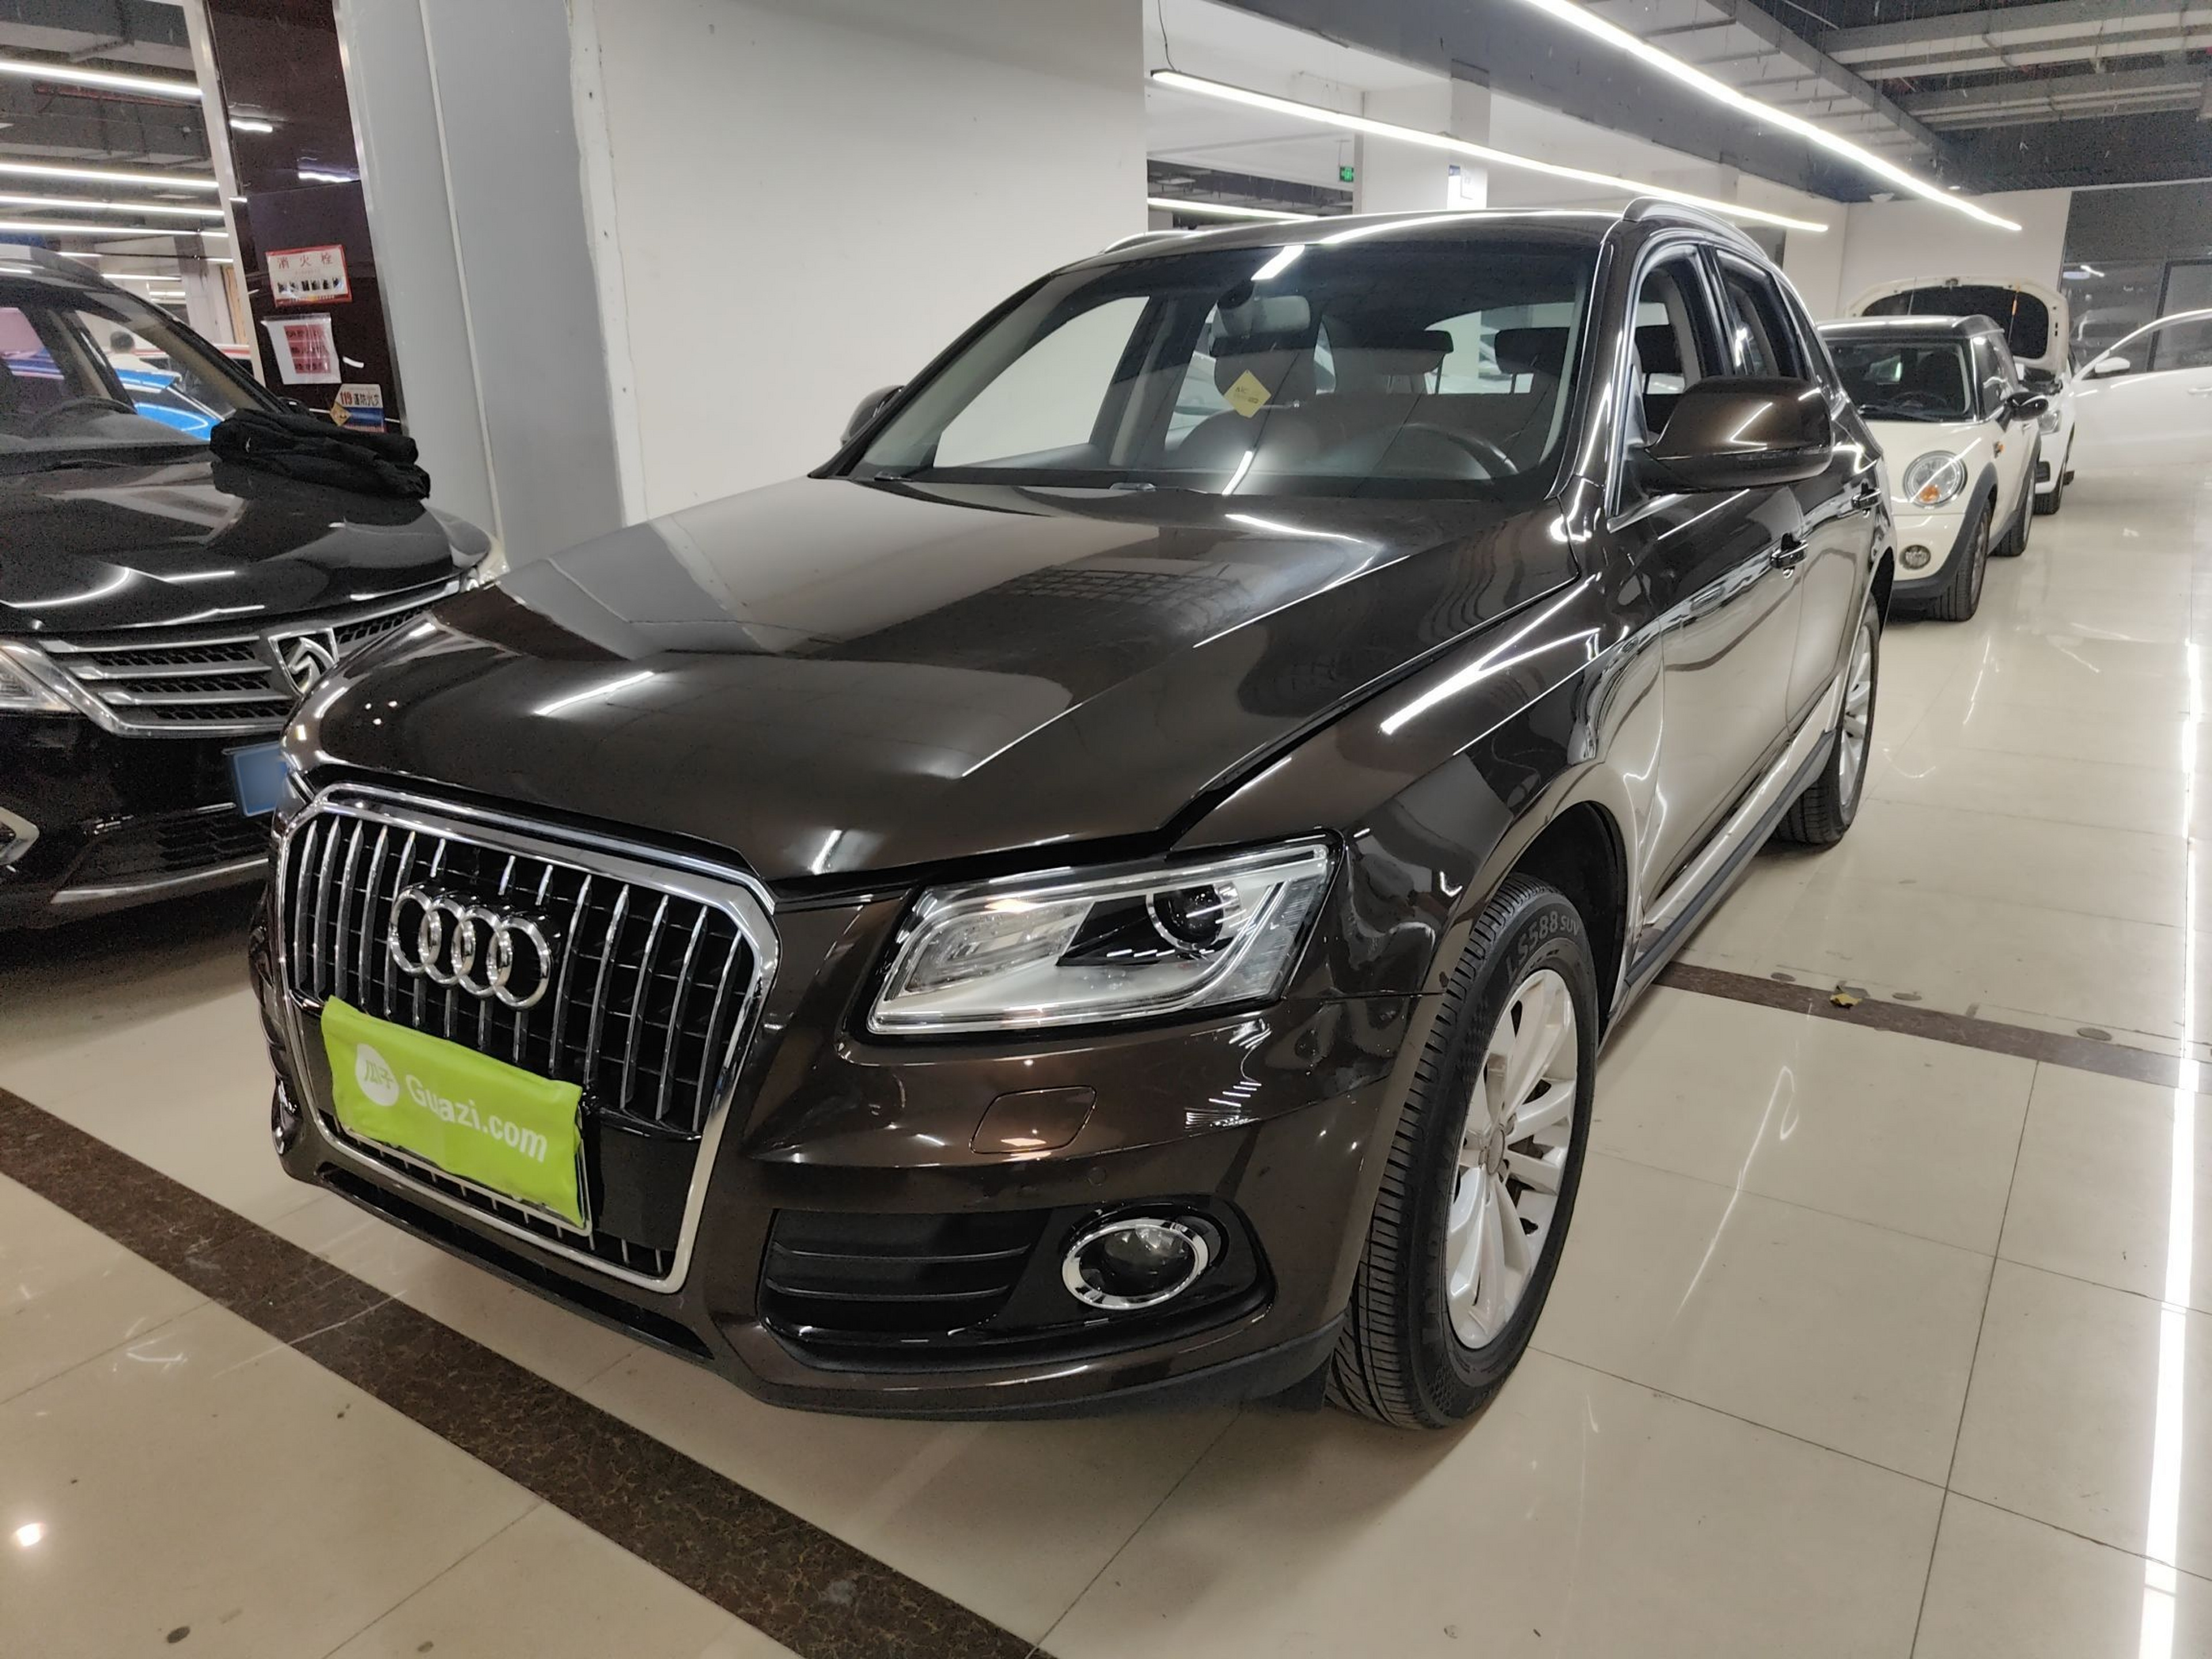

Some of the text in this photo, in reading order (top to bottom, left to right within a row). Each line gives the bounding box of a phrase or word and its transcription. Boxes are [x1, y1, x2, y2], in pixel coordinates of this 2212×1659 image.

[278, 253, 333, 269] 消火栓
[340, 391, 353, 405] 119
[1560, 915, 1580, 936] SUV
[405, 1074, 548, 1163] Guazi.com
